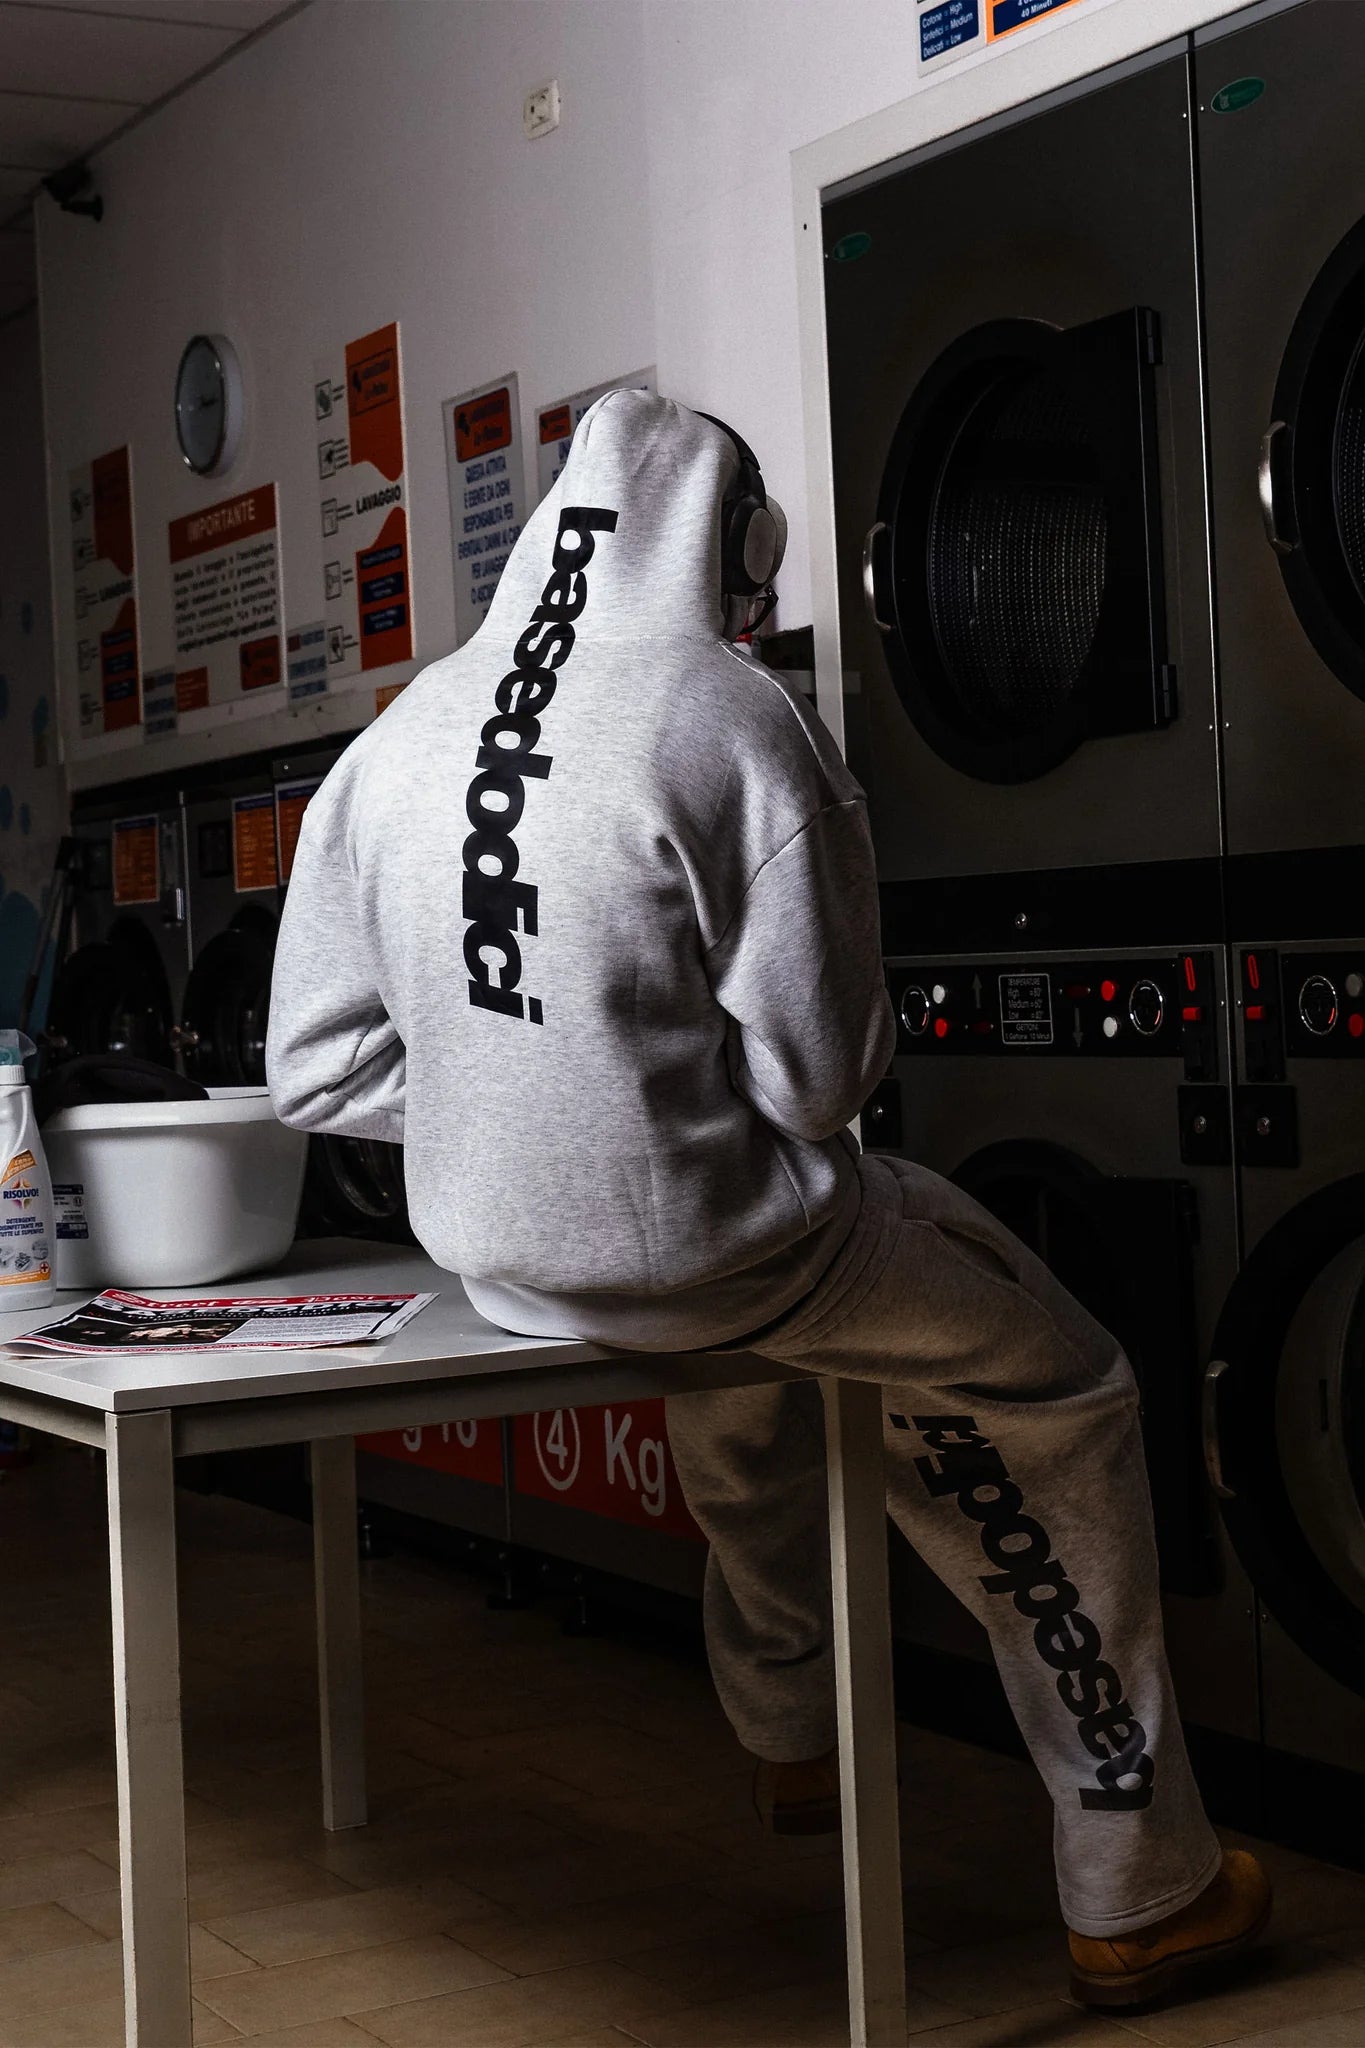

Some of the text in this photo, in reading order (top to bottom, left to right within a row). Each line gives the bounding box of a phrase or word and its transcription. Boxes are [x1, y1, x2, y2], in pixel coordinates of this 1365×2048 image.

[922, 12, 943, 29] Cotone
[949, 3, 963, 16] High
[950, 12, 974, 30] Medium
[1021, 9, 1030, 18] 40
[923, 41, 944, 58] Delicati
[950, 33, 962, 45] Low
[356, 485, 401, 515] LAVAGGIO
[187, 498, 256, 544] IMPORTANTE
[3, 1188, 39, 1200] RISOLVO!
[6, 1216, 36, 1225] DETERGENTE
[604, 1408, 665, 1517] Kg
